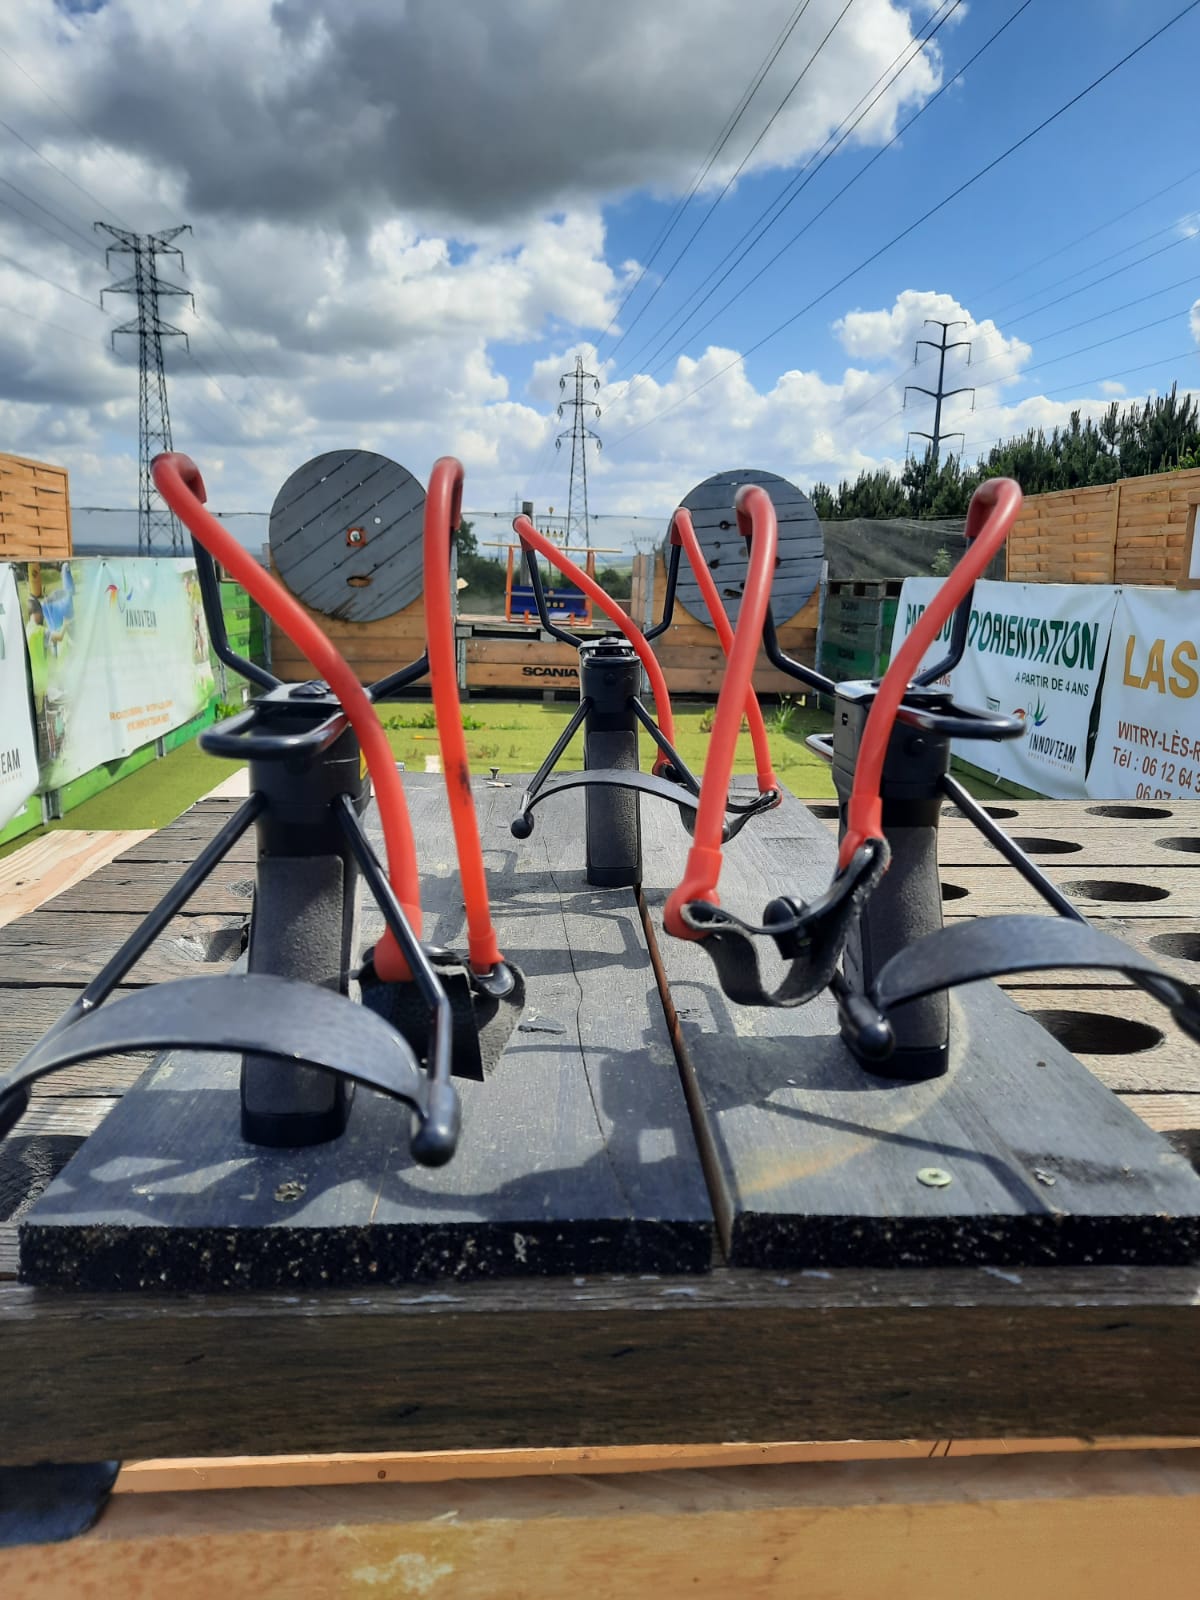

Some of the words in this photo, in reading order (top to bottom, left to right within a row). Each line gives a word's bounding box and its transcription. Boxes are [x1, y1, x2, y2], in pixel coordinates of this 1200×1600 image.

[967, 609, 1099, 671] D'ORIENTATION
[522, 666, 579, 678] SCANIA
[1014, 671, 1021, 683] A
[1021, 672, 1049, 689] PARTIR
[1051, 678, 1064, 692] DE
[1065, 680, 1070, 692] 4
[1071, 682, 1090, 697] ANS
[1029, 732, 1077, 764] INNOVTEAM
[1113, 746, 1132, 769] Tél
[1142, 755, 1158, 777] 06
[1161, 761, 1176, 783] 12
[1178, 767, 1193, 790] 64
